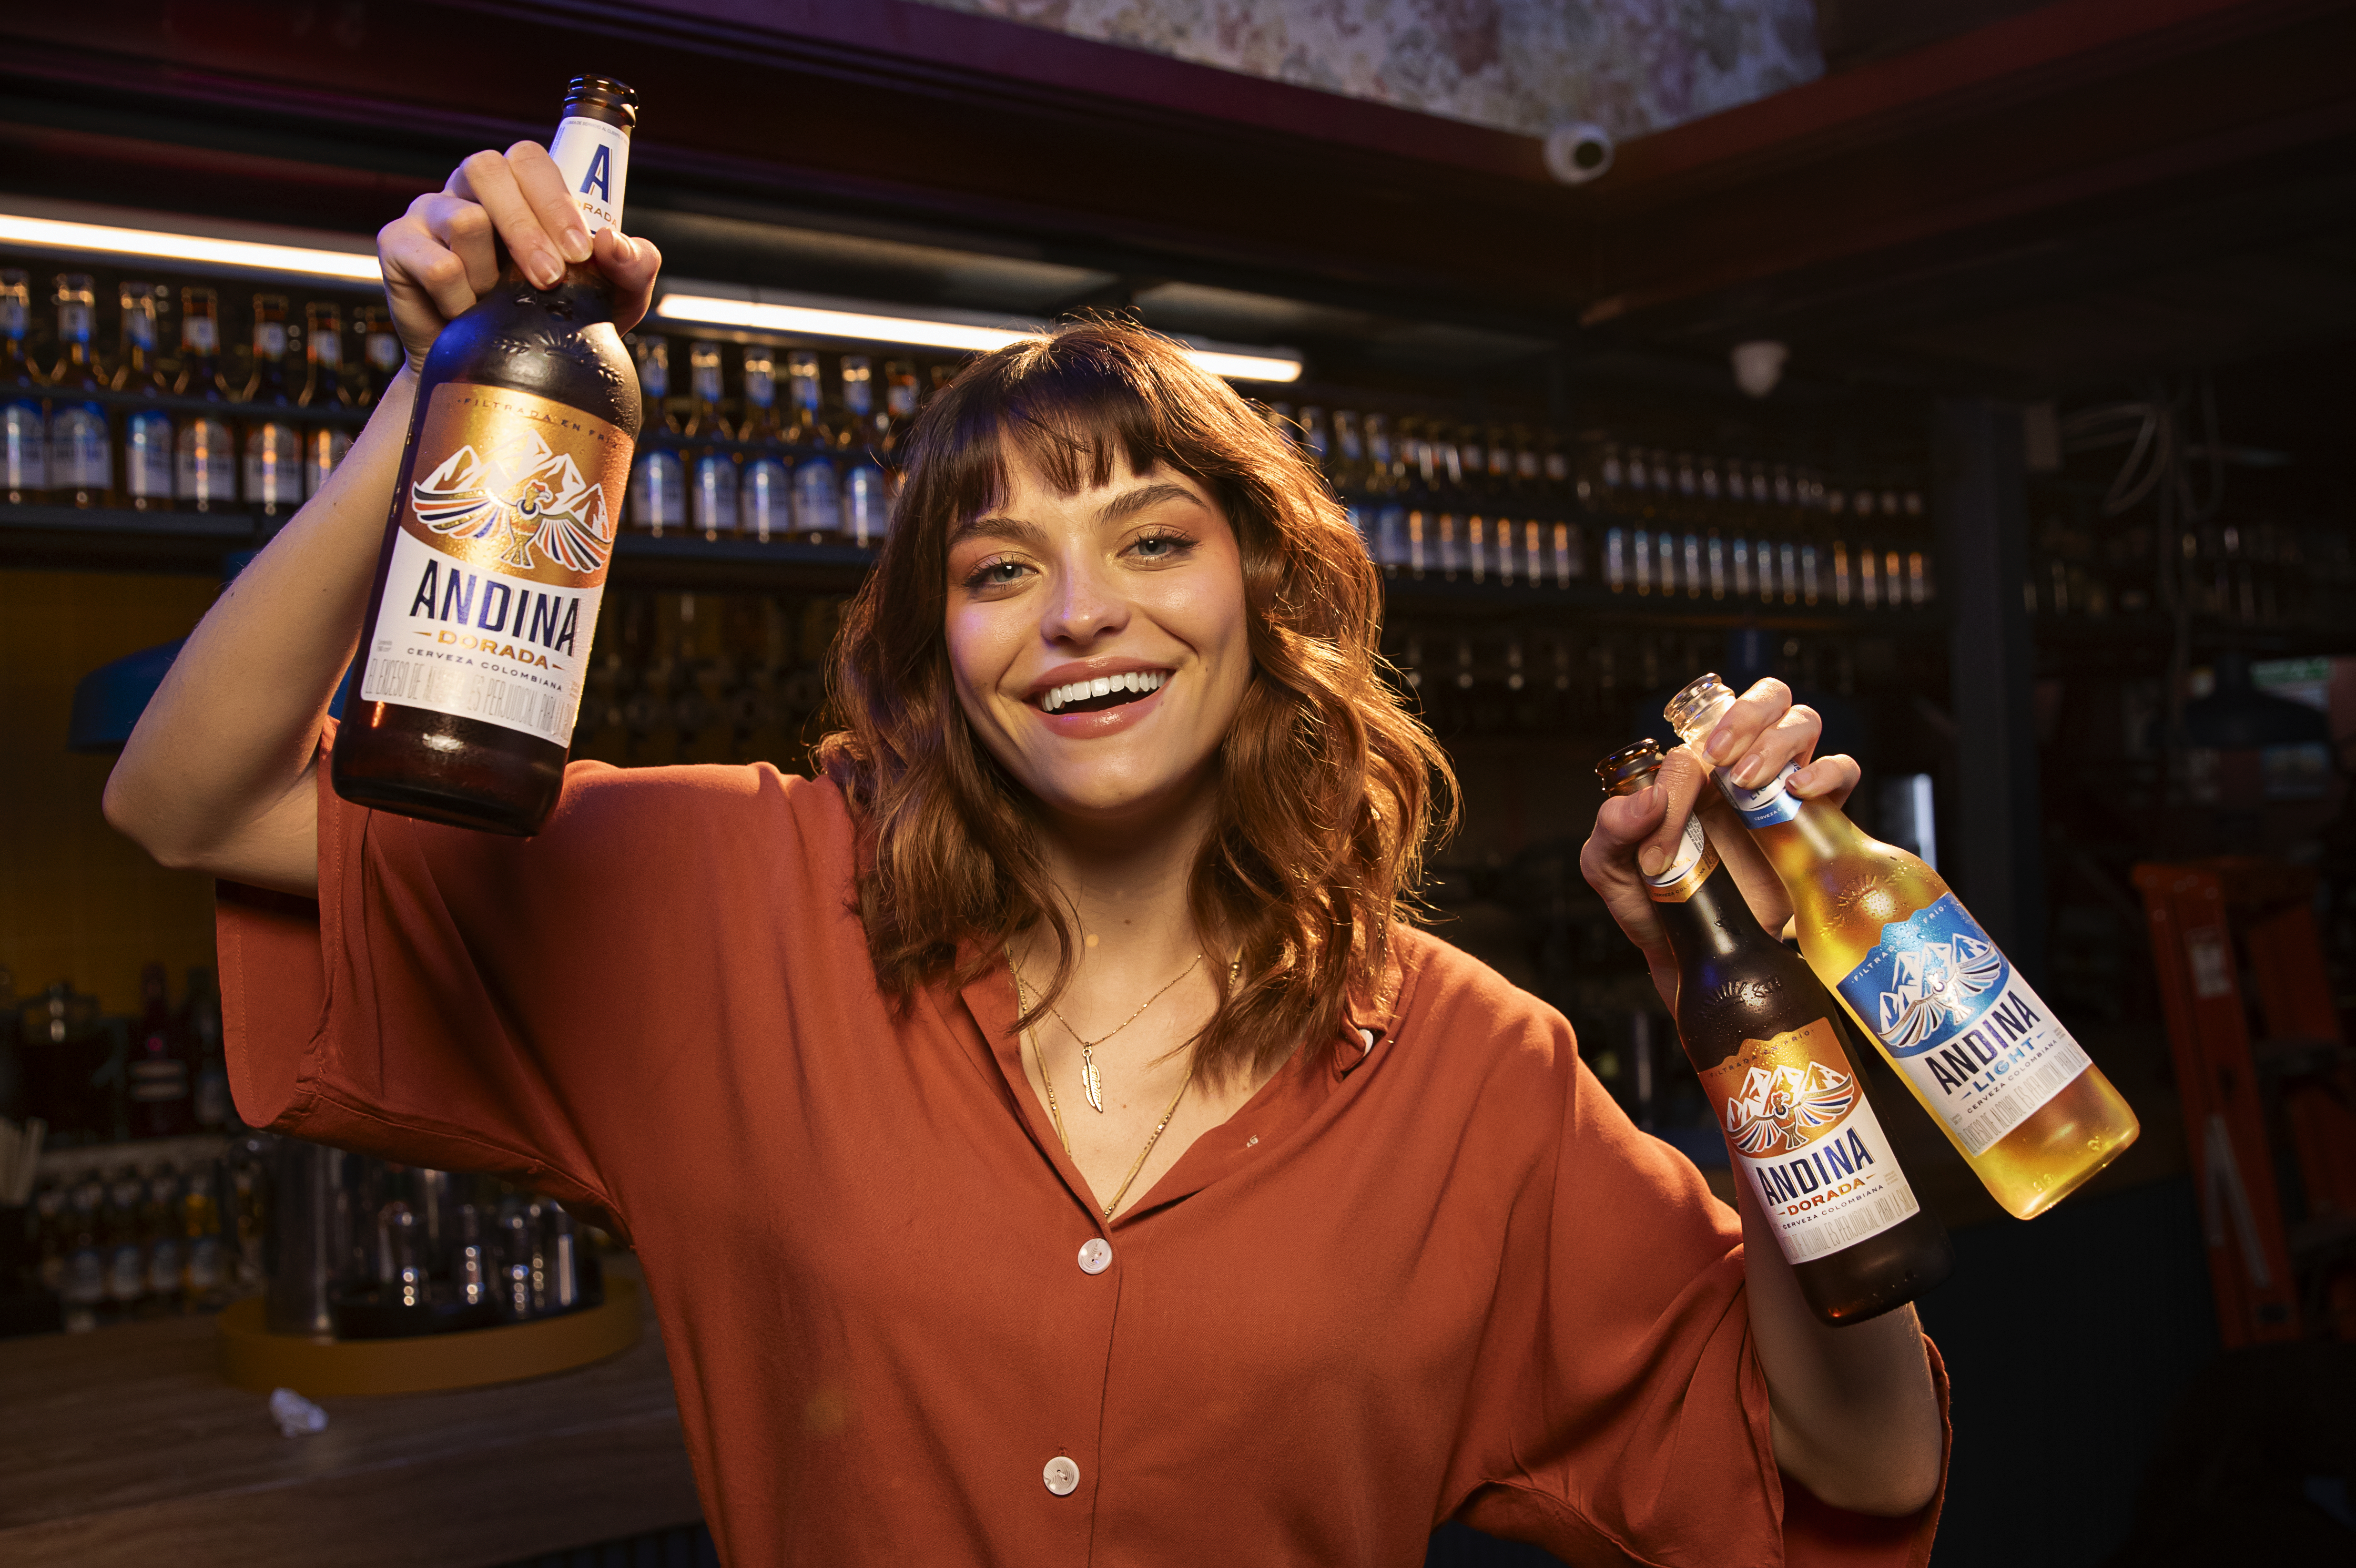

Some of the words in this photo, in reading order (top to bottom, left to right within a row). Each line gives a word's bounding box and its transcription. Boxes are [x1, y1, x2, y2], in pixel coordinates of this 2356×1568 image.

[580, 144, 612, 205] A
[573, 199, 617, 228] RADA
[464, 398, 551, 422] FILTRADA
[561, 420, 580, 432] EN
[409, 559, 582, 657] ANDINA
[407, 647, 473, 665] CERVEZA
[481, 661, 562, 691] COLOMBIANA
[438, 630, 548, 670] DORADA
[1754, 810, 1778, 821] CERVEZA
[1675, 868, 1705, 894] COLOMBIANA
[1924, 990, 2041, 1095] ANDINA
[1710, 1055, 1758, 1077] FILTRADA
[1967, 1082, 2006, 1114] CERVEZA
[2007, 1039, 2057, 1081] COLOMBIANA
[1972, 1037, 2034, 1092] LIGHT
[1755, 1126, 1876, 1206] ANDINA
[1782, 1214, 1819, 1229] CERVEZA
[1822, 1185, 1884, 1215] COLOMBIANA
[1786, 1177, 1866, 1216] DORADA
[1824, 1221, 1840, 1246] ES
